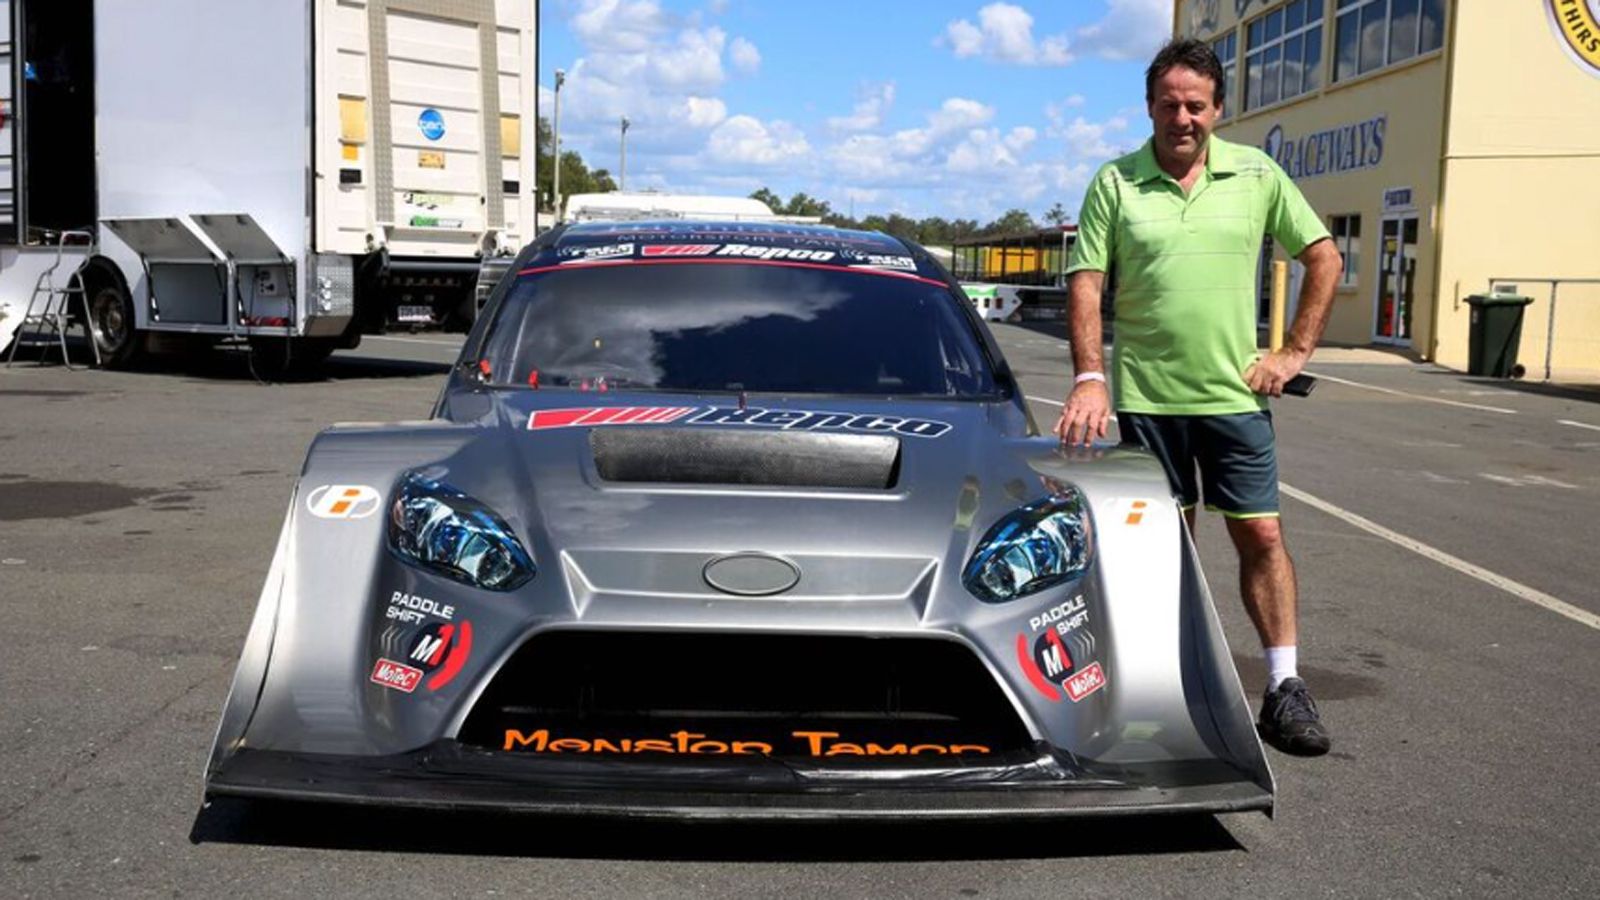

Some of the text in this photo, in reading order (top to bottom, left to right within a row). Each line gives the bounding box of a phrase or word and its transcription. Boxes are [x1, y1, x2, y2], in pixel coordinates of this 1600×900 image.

[1282, 114, 1388, 179] RACEWAYS
[716, 243, 835, 261] Repco
[688, 406, 952, 438] Repco
[386, 606, 426, 625] SHIFT
[391, 591, 455, 619] PADDLE
[1029, 595, 1085, 631] PADDLE
[1056, 610, 1089, 635] SHIFT
